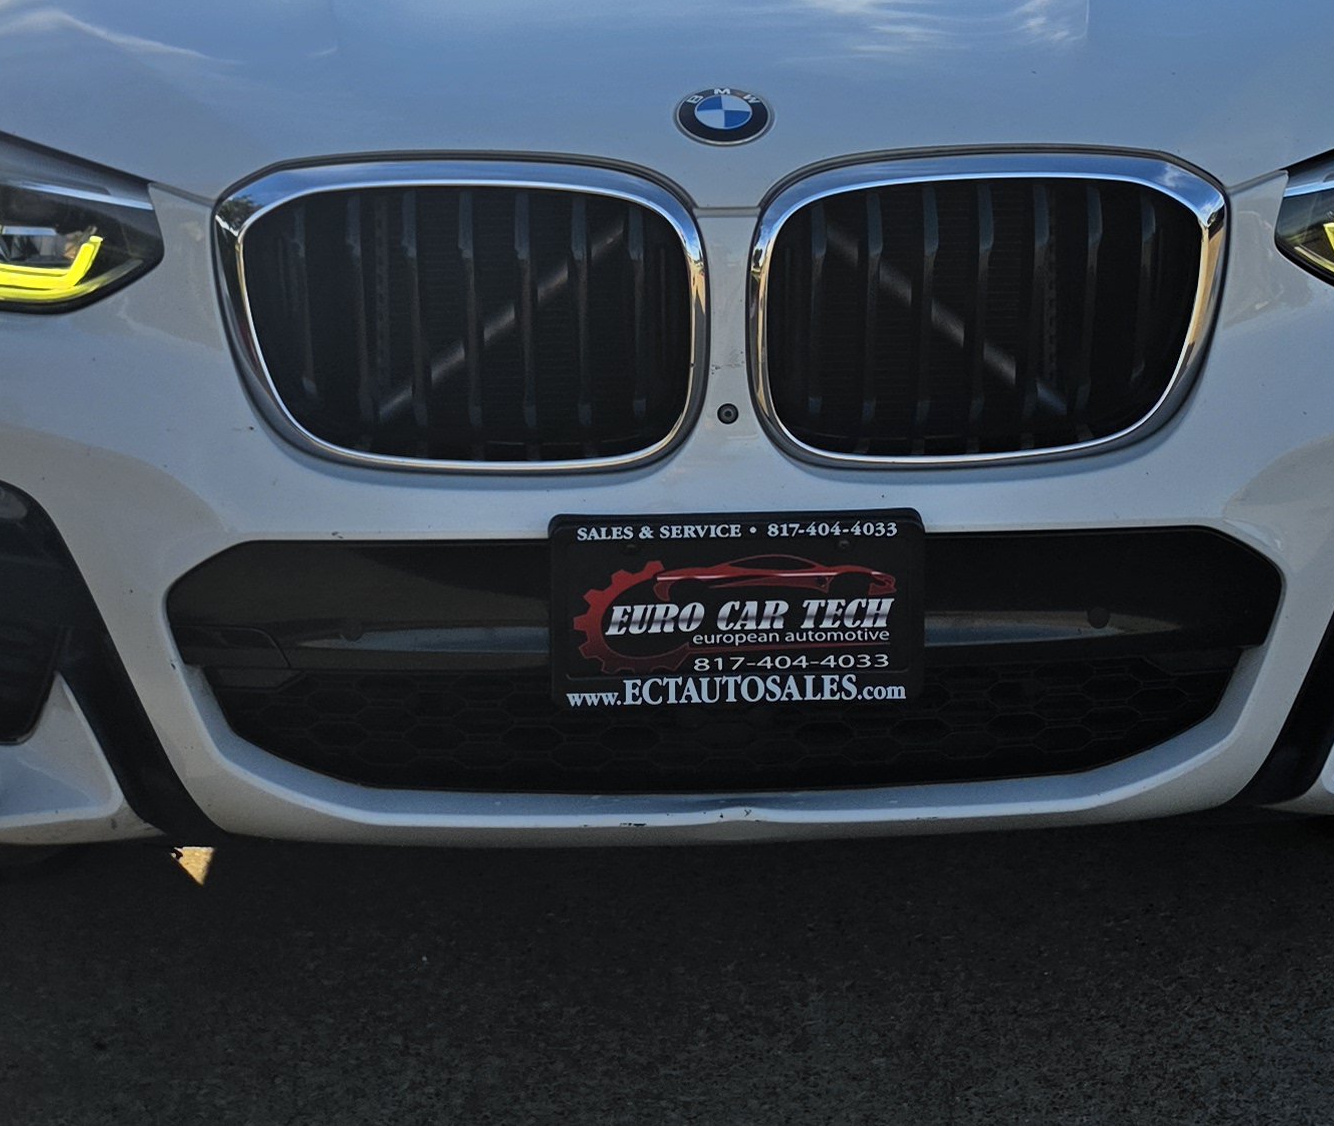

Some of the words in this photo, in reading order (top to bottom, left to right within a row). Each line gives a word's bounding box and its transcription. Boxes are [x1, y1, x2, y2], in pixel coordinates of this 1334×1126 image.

[686, 88, 761, 104] BMW
[577, 526, 634, 541] SALES
[638, 525, 654, 539] &
[659, 523, 742, 539] SERVICE
[767, 521, 898, 537] 817-404-4033
[605, 601, 705, 636] EURO
[716, 600, 787, 632] CAR
[801, 598, 894, 629] TECH
[692, 632, 779, 646] european
[785, 629, 889, 643] automotive
[693, 654, 889, 671] 817-404-4033
[567, 674, 907, 707] www.ECTAUTOSALES.com
